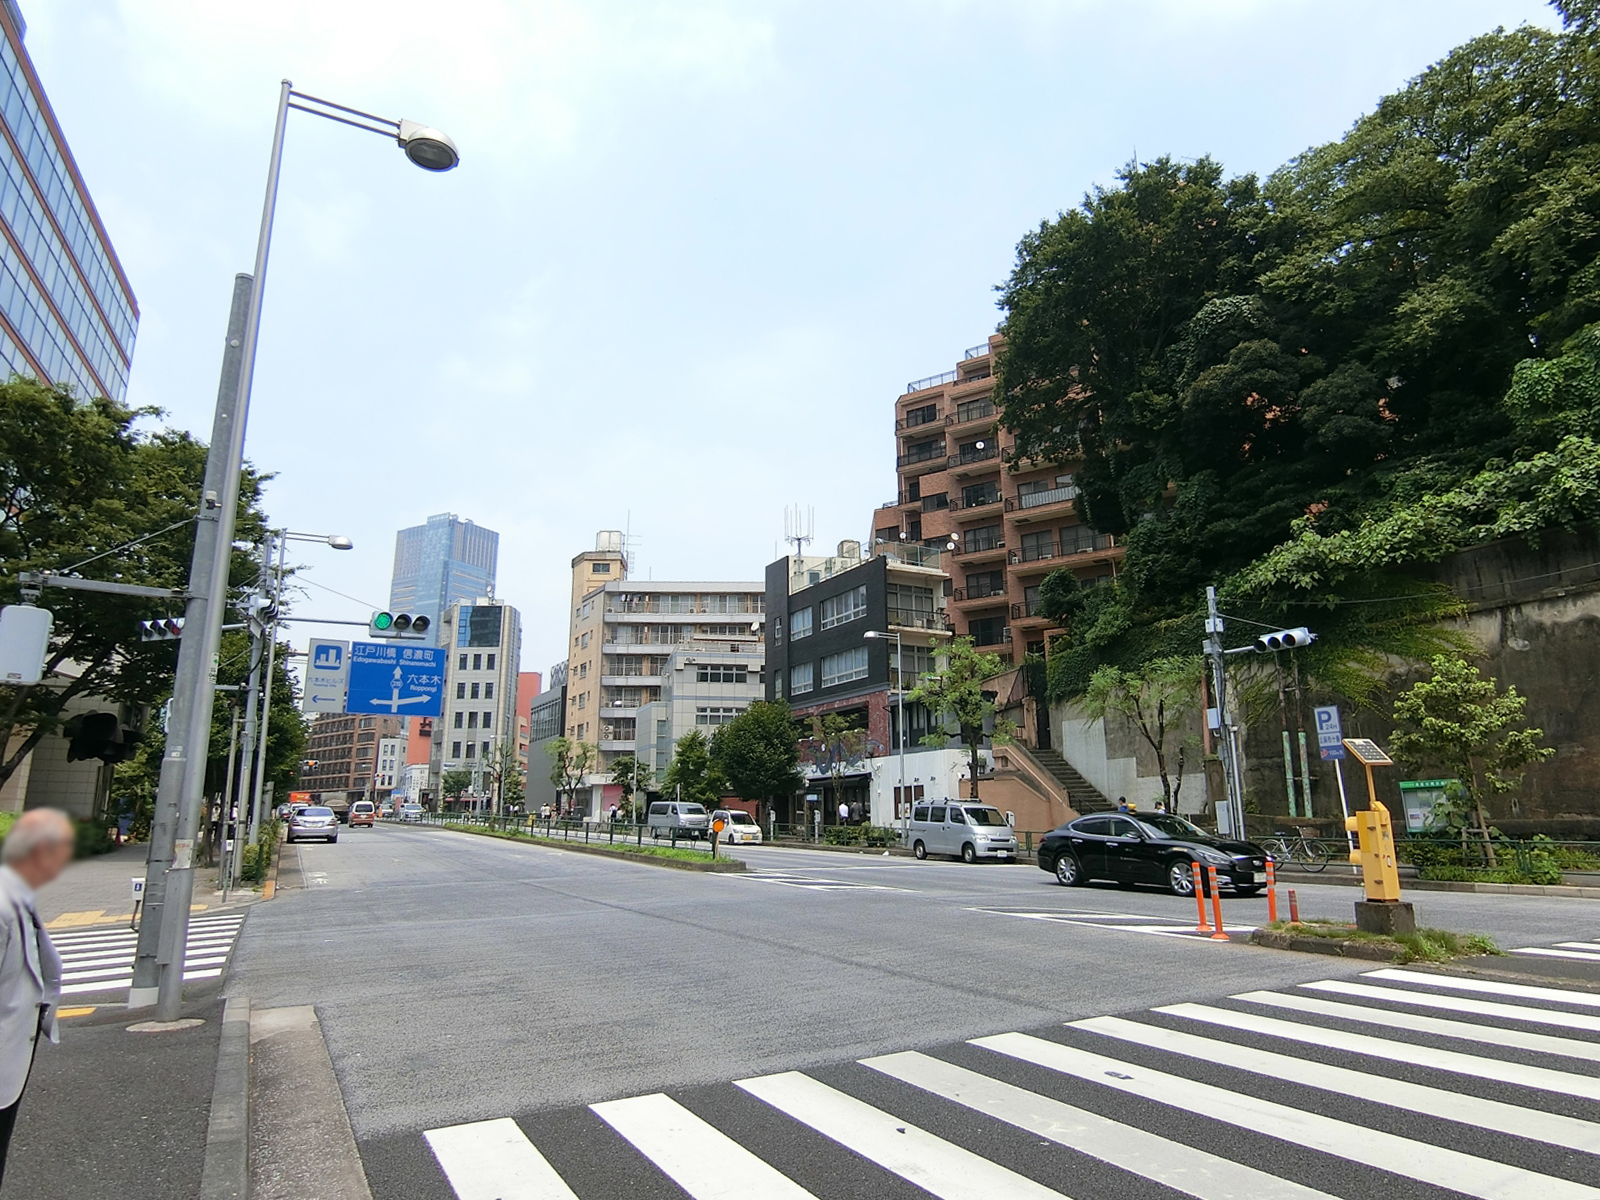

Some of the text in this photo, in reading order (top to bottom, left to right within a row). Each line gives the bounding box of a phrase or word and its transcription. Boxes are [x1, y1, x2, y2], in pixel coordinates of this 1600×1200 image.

[354, 645, 434, 661] 江戸川橋 信濃町
[353, 656, 436, 667] Edogawabashi Shinanomachi
[406, 674, 441, 685] 六本木
[410, 685, 437, 693] Roppongi
[1317, 710, 1332, 730] P
